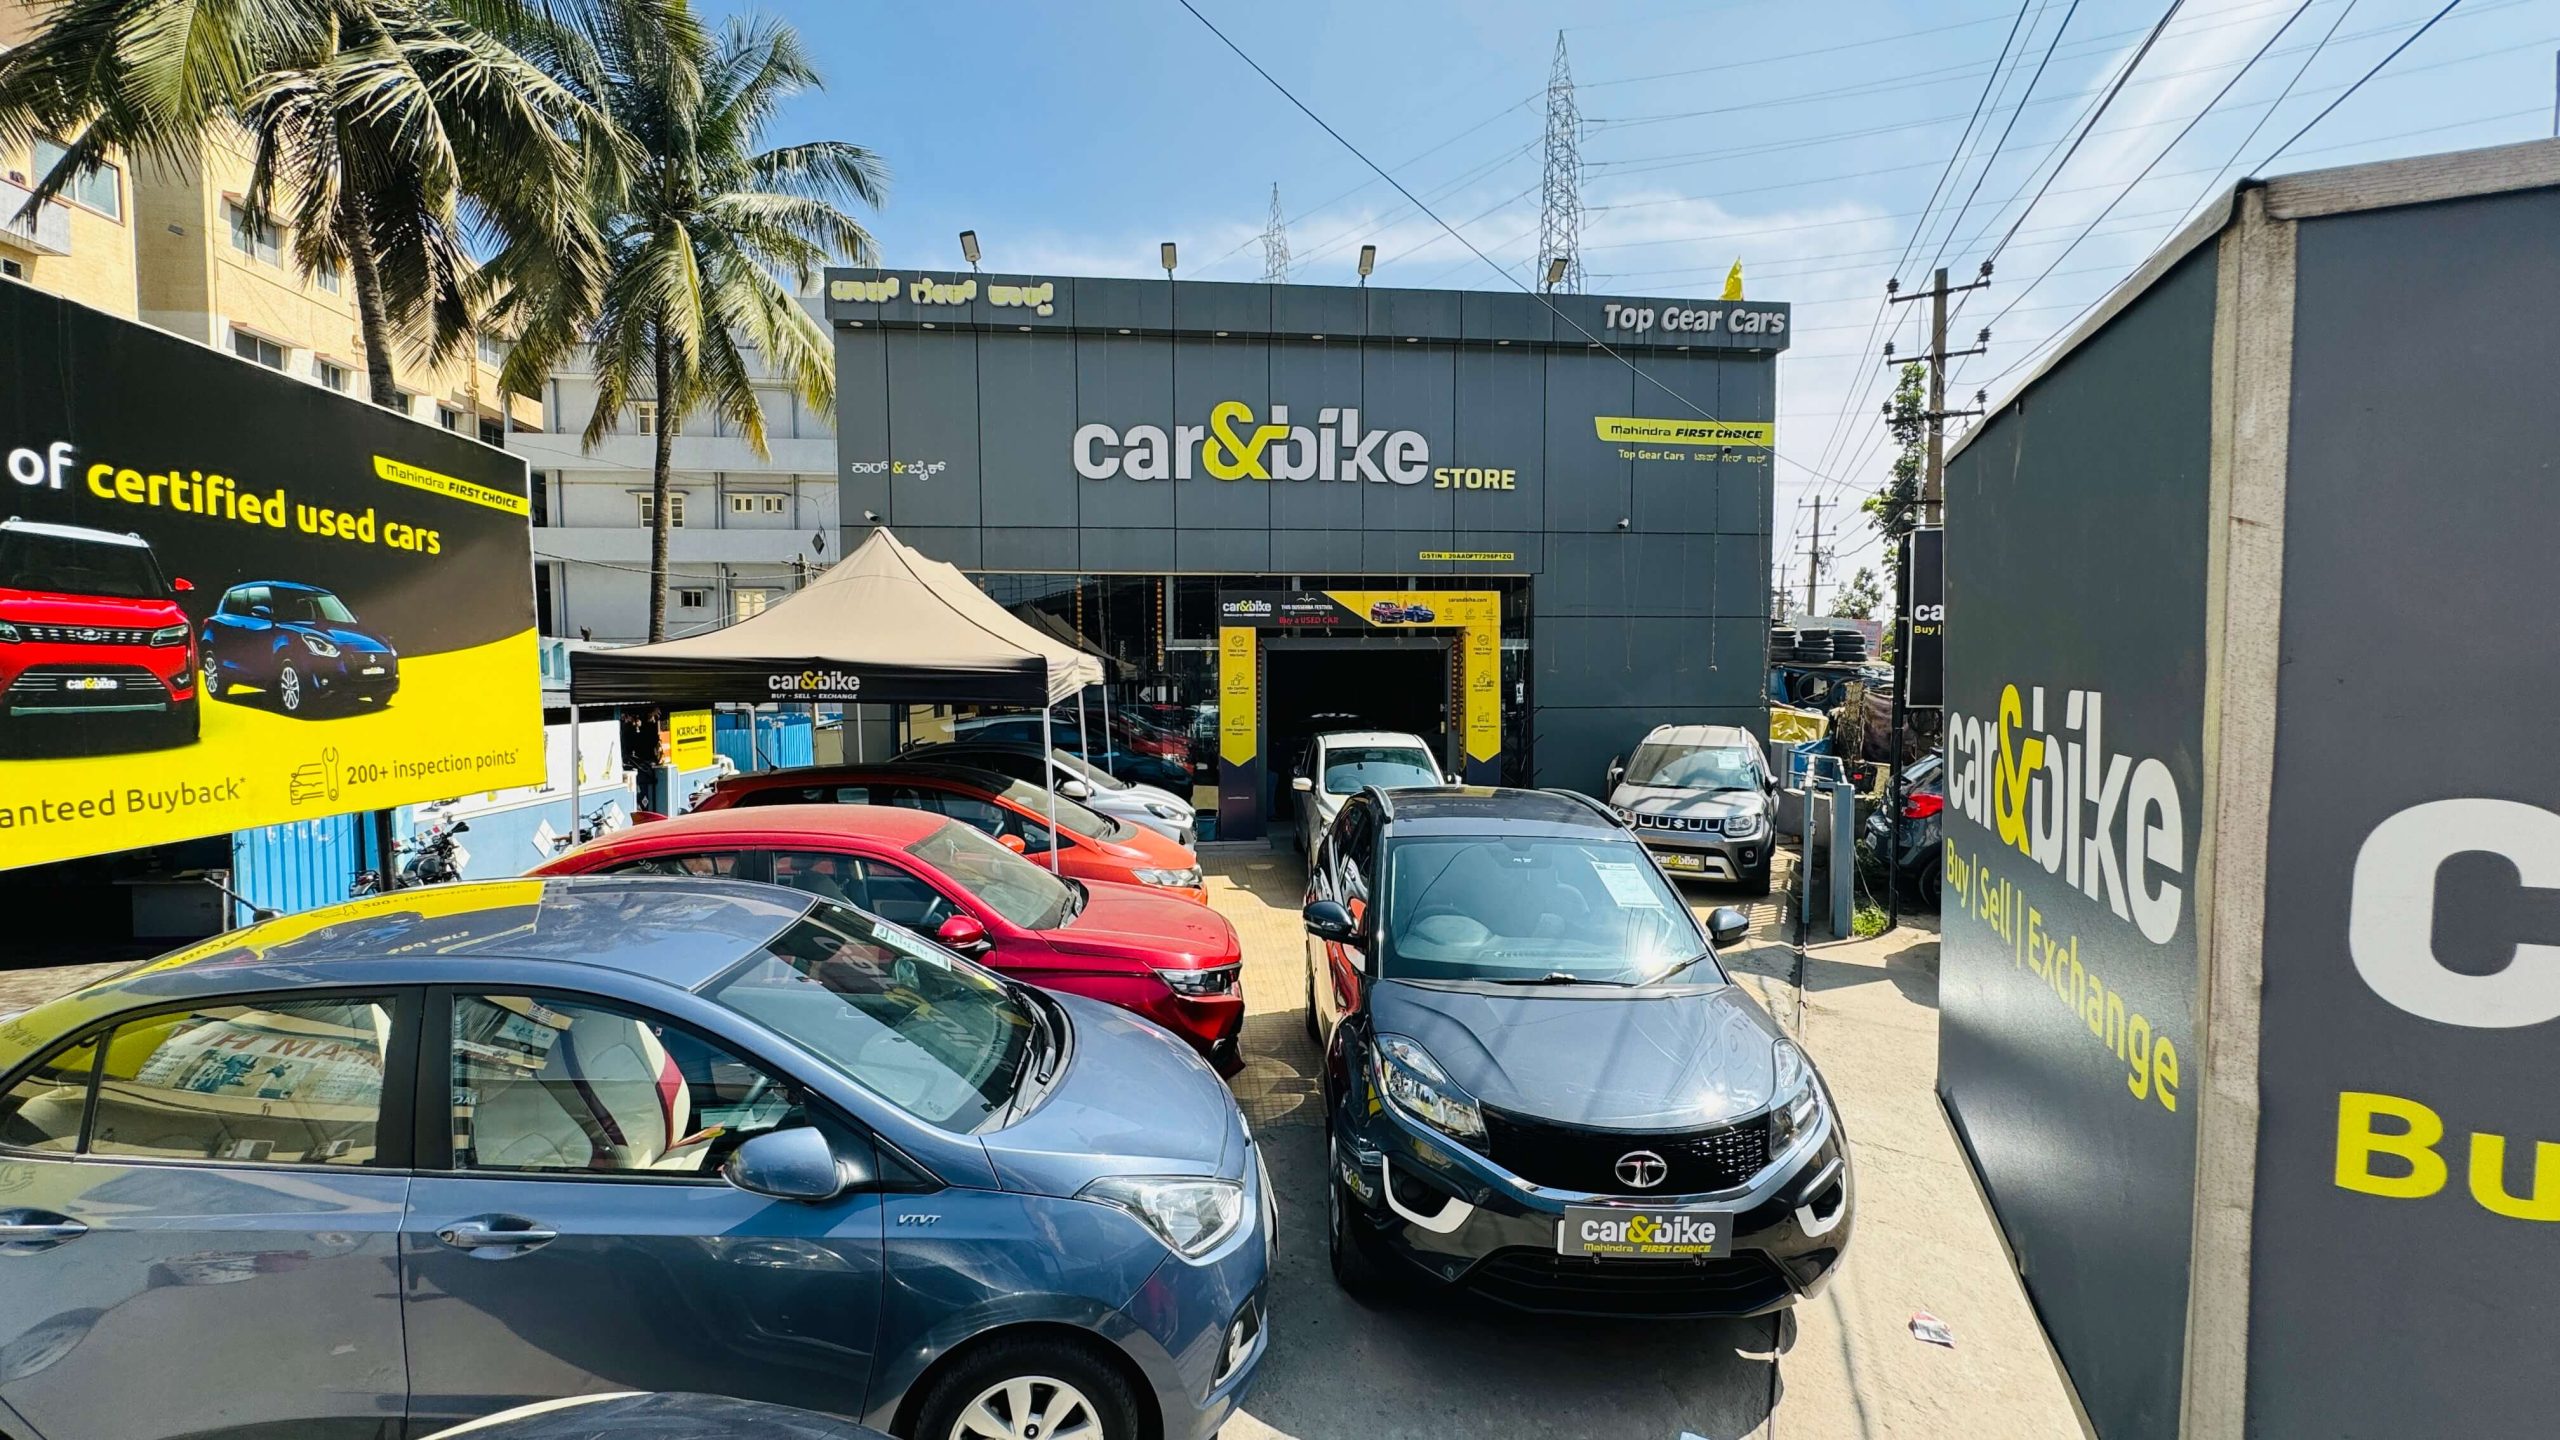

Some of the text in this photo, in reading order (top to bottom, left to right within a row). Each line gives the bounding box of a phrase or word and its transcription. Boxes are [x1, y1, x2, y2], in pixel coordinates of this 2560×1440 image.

[1604, 304, 1786, 334] Top Gear Cars
[1073, 400, 1516, 490] car&bike STORE
[1611, 425, 1763, 439] Mahindra FIRST CHOICE
[1618, 449, 1685, 461] Top Gear Cars
[7, 441, 441, 555] of certified used cars
[386, 464, 518, 509] Mahindra FIRST CHOICE
[1223, 600, 1271, 612] car&bike
[1914, 625, 1935, 635] Buy
[768, 670, 860, 690] car&bike
[347, 764, 389, 785] 200+
[393, 754, 472, 780] inspection
[1948, 684, 2183, 945] car&bike
[1945, 837, 1970, 909] Buy
[1979, 866, 2012, 946] Sell
[2028, 906, 2180, 1113] Exchange
[898, 1214, 942, 1224] VTVT
[1581, 1215, 1716, 1244] car&bike
[1584, 1243, 1712, 1253] Mahindra FIRST CHOICE
